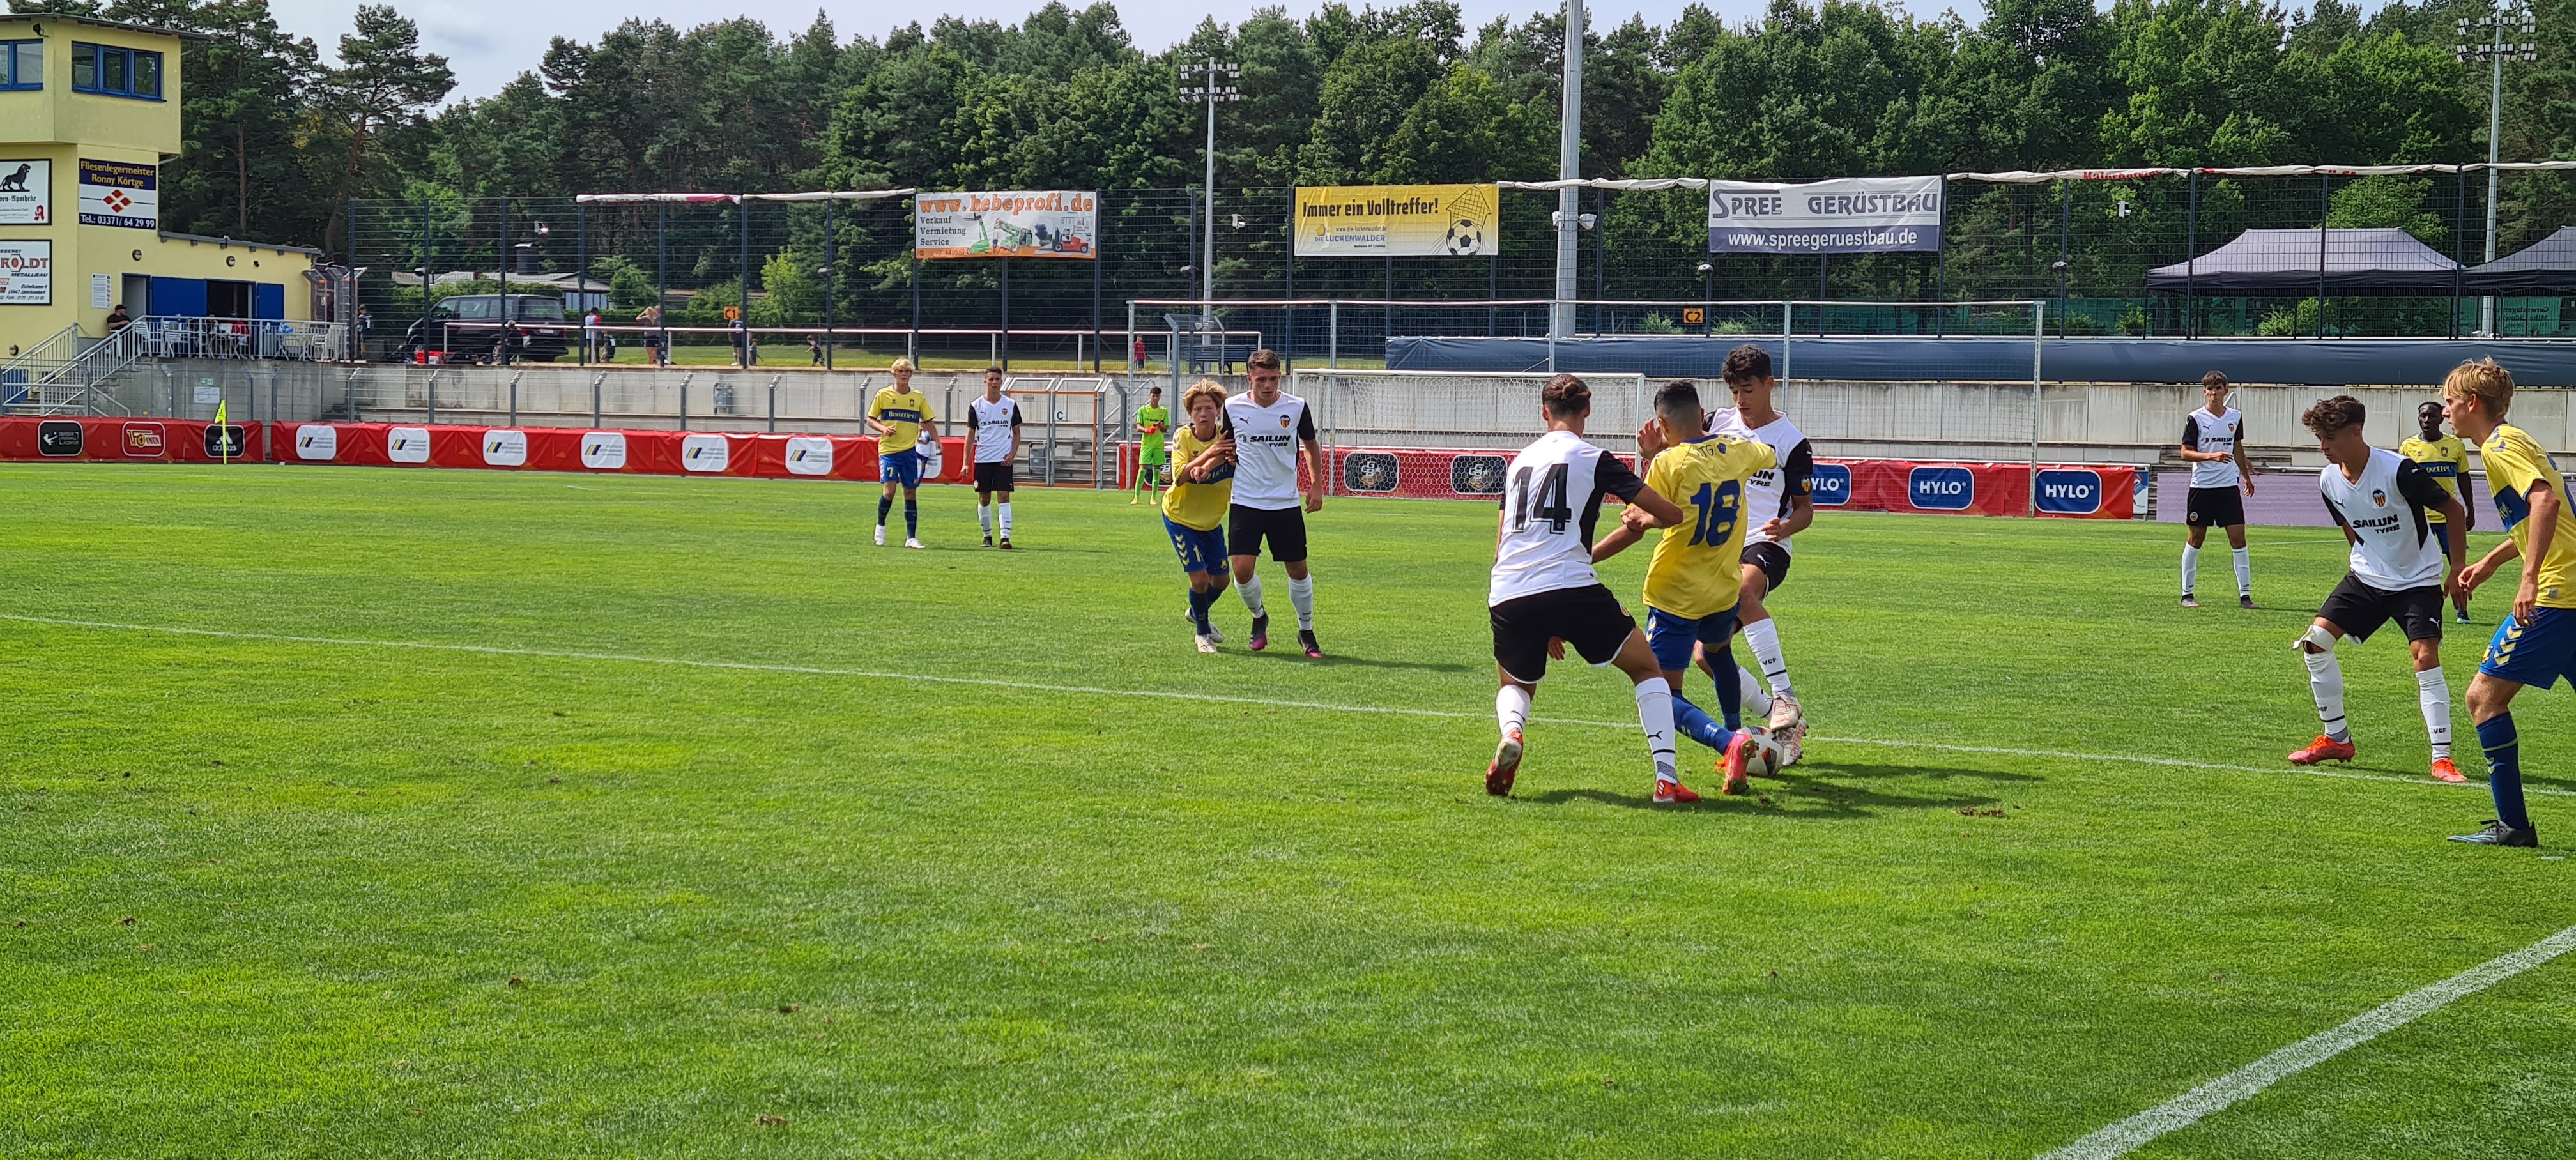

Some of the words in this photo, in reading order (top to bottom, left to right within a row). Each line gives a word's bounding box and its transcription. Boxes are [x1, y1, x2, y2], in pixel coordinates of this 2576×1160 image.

[80, 160, 155, 176] Fliesenlegermeister
[91, 173, 116, 187] Ronny
[117, 176, 144, 188] Körtge
[919, 193, 1093, 215] www.hebeprofi.de
[1303, 202, 1340, 217] Immer
[1345, 199, 1363, 217] ein
[1367, 197, 1439, 216] Volltreffer!
[1712, 188, 1782, 218] SPREE
[1807, 192, 1938, 216] GERÜSTBAU
[80, 214, 96, 224] Tel.:
[97, 215, 123, 226] 03371/
[124, 218, 133, 226] 64
[135, 218, 144, 227] 29
[146, 220, 155, 228] 99
[920, 227, 966, 236] Vermietung
[1728, 228, 1917, 250] www.spreegeruestbau.de
[725, 309, 735, 319] C1
[1685, 311, 1701, 322] C2
[1057, 411, 1064, 420] C
[887, 467, 893, 477] 7
[1511, 463, 1572, 534] 14
[1687, 480, 1740, 547] 18
[2352, 514, 2398, 528] SAILUN
[2375, 524, 2400, 534] TYRE
